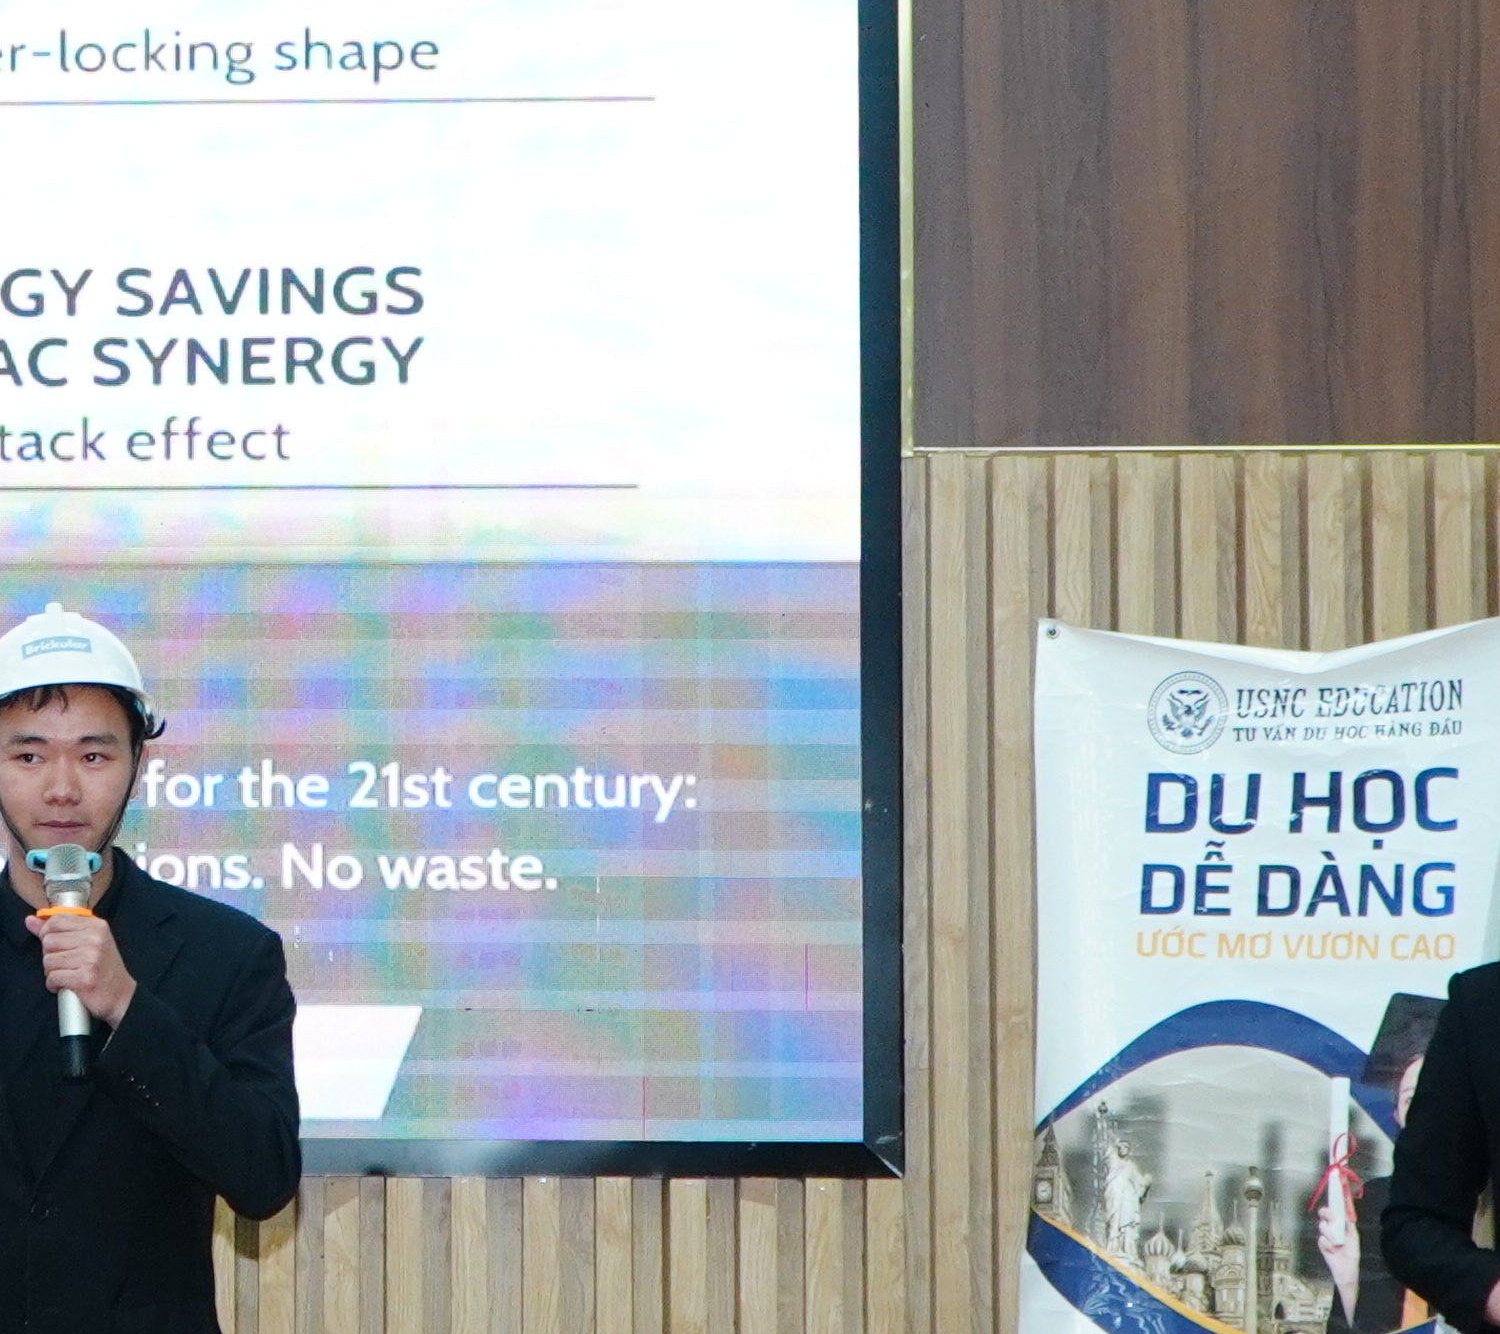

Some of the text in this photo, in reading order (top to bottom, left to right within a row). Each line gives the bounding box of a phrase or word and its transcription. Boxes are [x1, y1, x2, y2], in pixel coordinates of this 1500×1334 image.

[276, 27, 438, 83] shape
[117, 266, 423, 317] SAVINGS
[94, 337, 423, 386] SYNERGY
[127, 416, 289, 461] effect
[26, 640, 88, 656] Brickular
[1236, 679, 1463, 718] USNC EDUCATION
[143, 759, 696, 822] for the 21st century:
[1144, 768, 1458, 849] DU HỌC
[282, 843, 557, 890] No waste.
[1139, 841, 1456, 917] DỄ DÀNG
[1390, 933, 1455, 960] CAO
